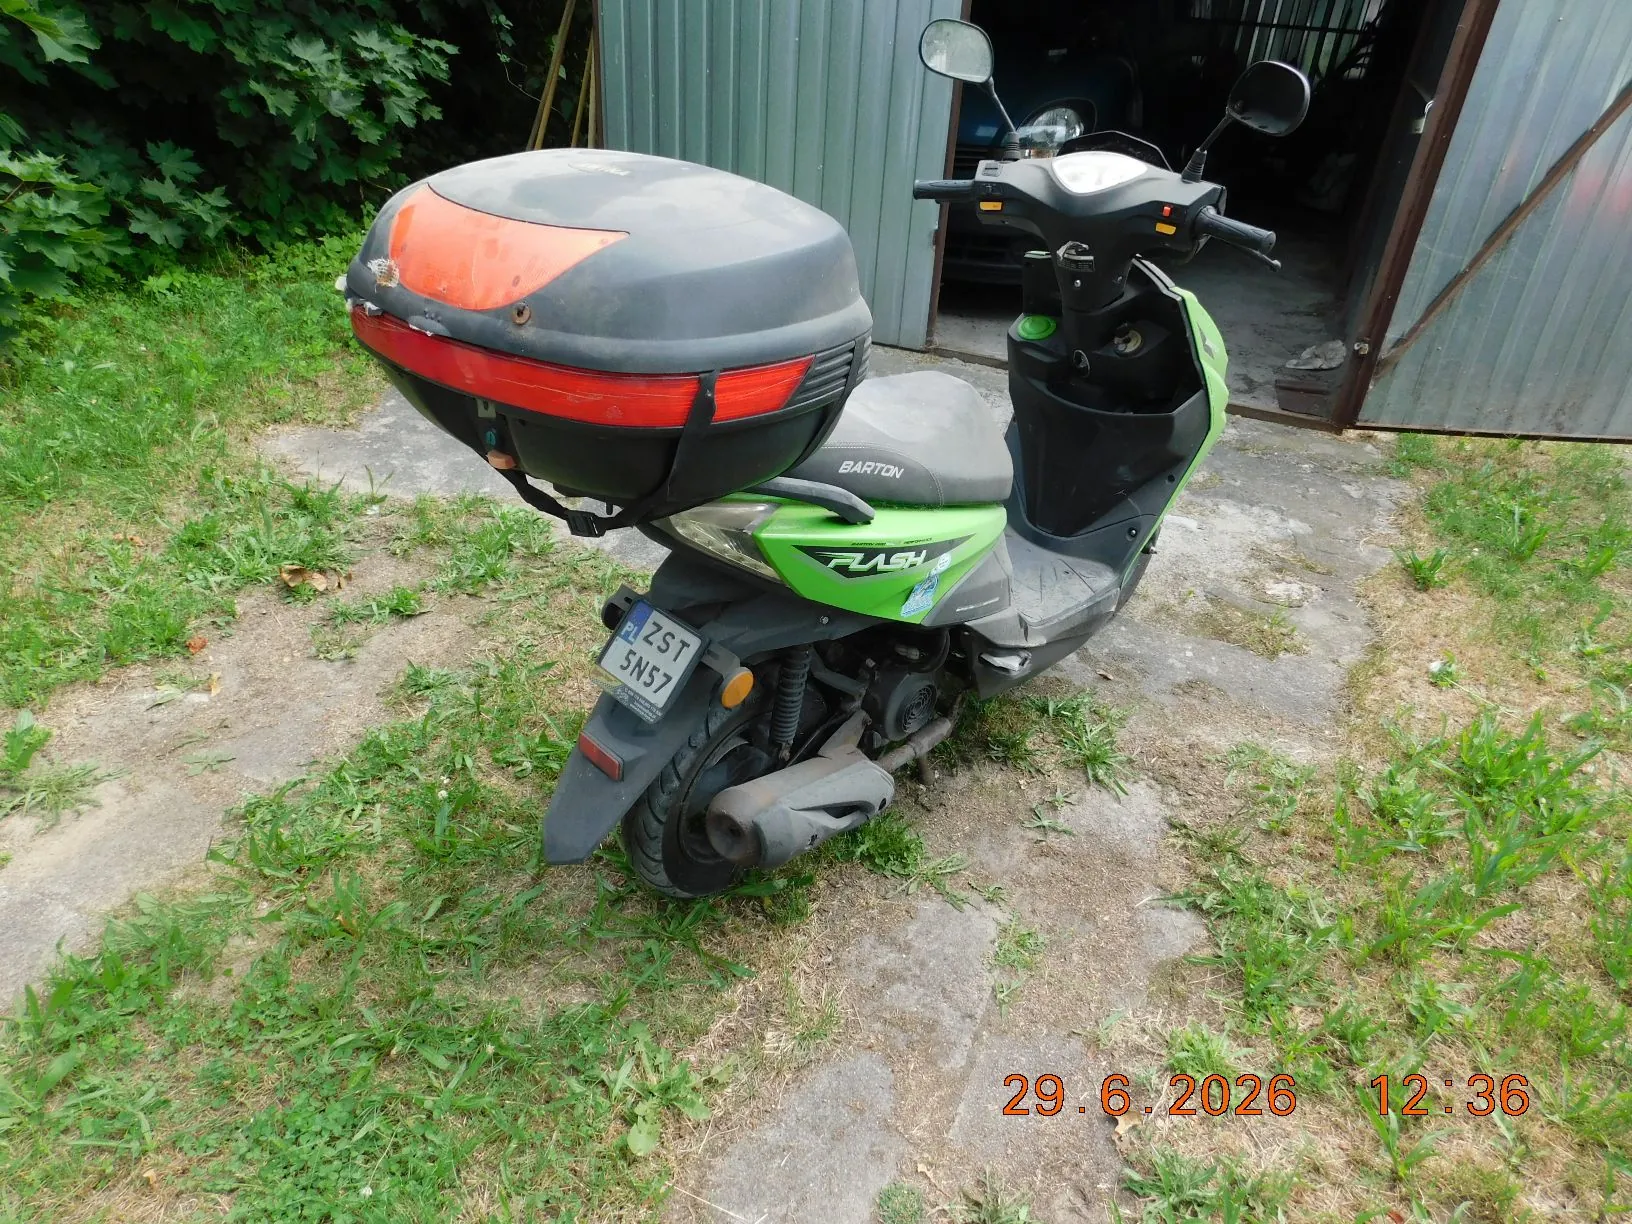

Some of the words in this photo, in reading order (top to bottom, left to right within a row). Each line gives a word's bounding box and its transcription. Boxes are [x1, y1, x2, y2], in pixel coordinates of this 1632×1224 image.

[838, 461, 904, 479] BARTON
[815, 549, 927, 573] FLASH
[621, 621, 636, 643] PL
[642, 621, 691, 663] ZST
[619, 648, 673, 694] 5N57
